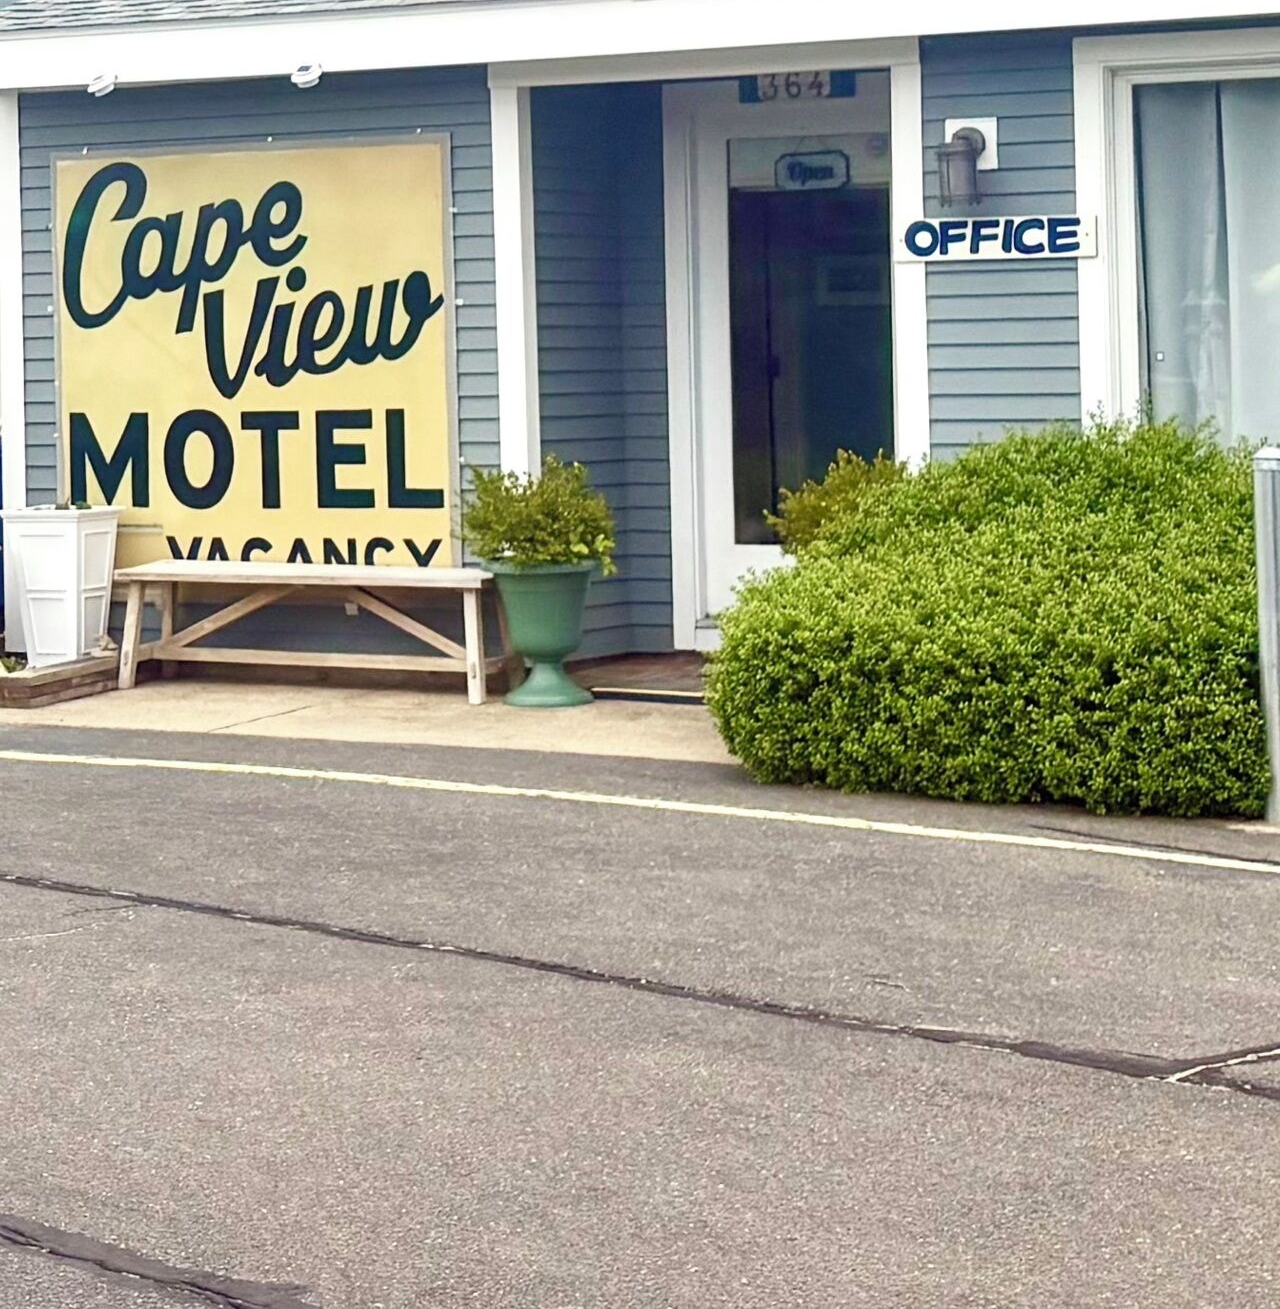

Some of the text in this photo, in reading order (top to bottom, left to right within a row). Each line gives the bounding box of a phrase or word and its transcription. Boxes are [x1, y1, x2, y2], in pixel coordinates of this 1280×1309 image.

[761, 71, 825, 102] 364
[786, 161, 835, 187] Open
[63, 162, 308, 334] Cape
[904, 218, 1081, 257] OFFICE
[203, 266, 445, 400] View
[69, 408, 445, 510] MOTEL
